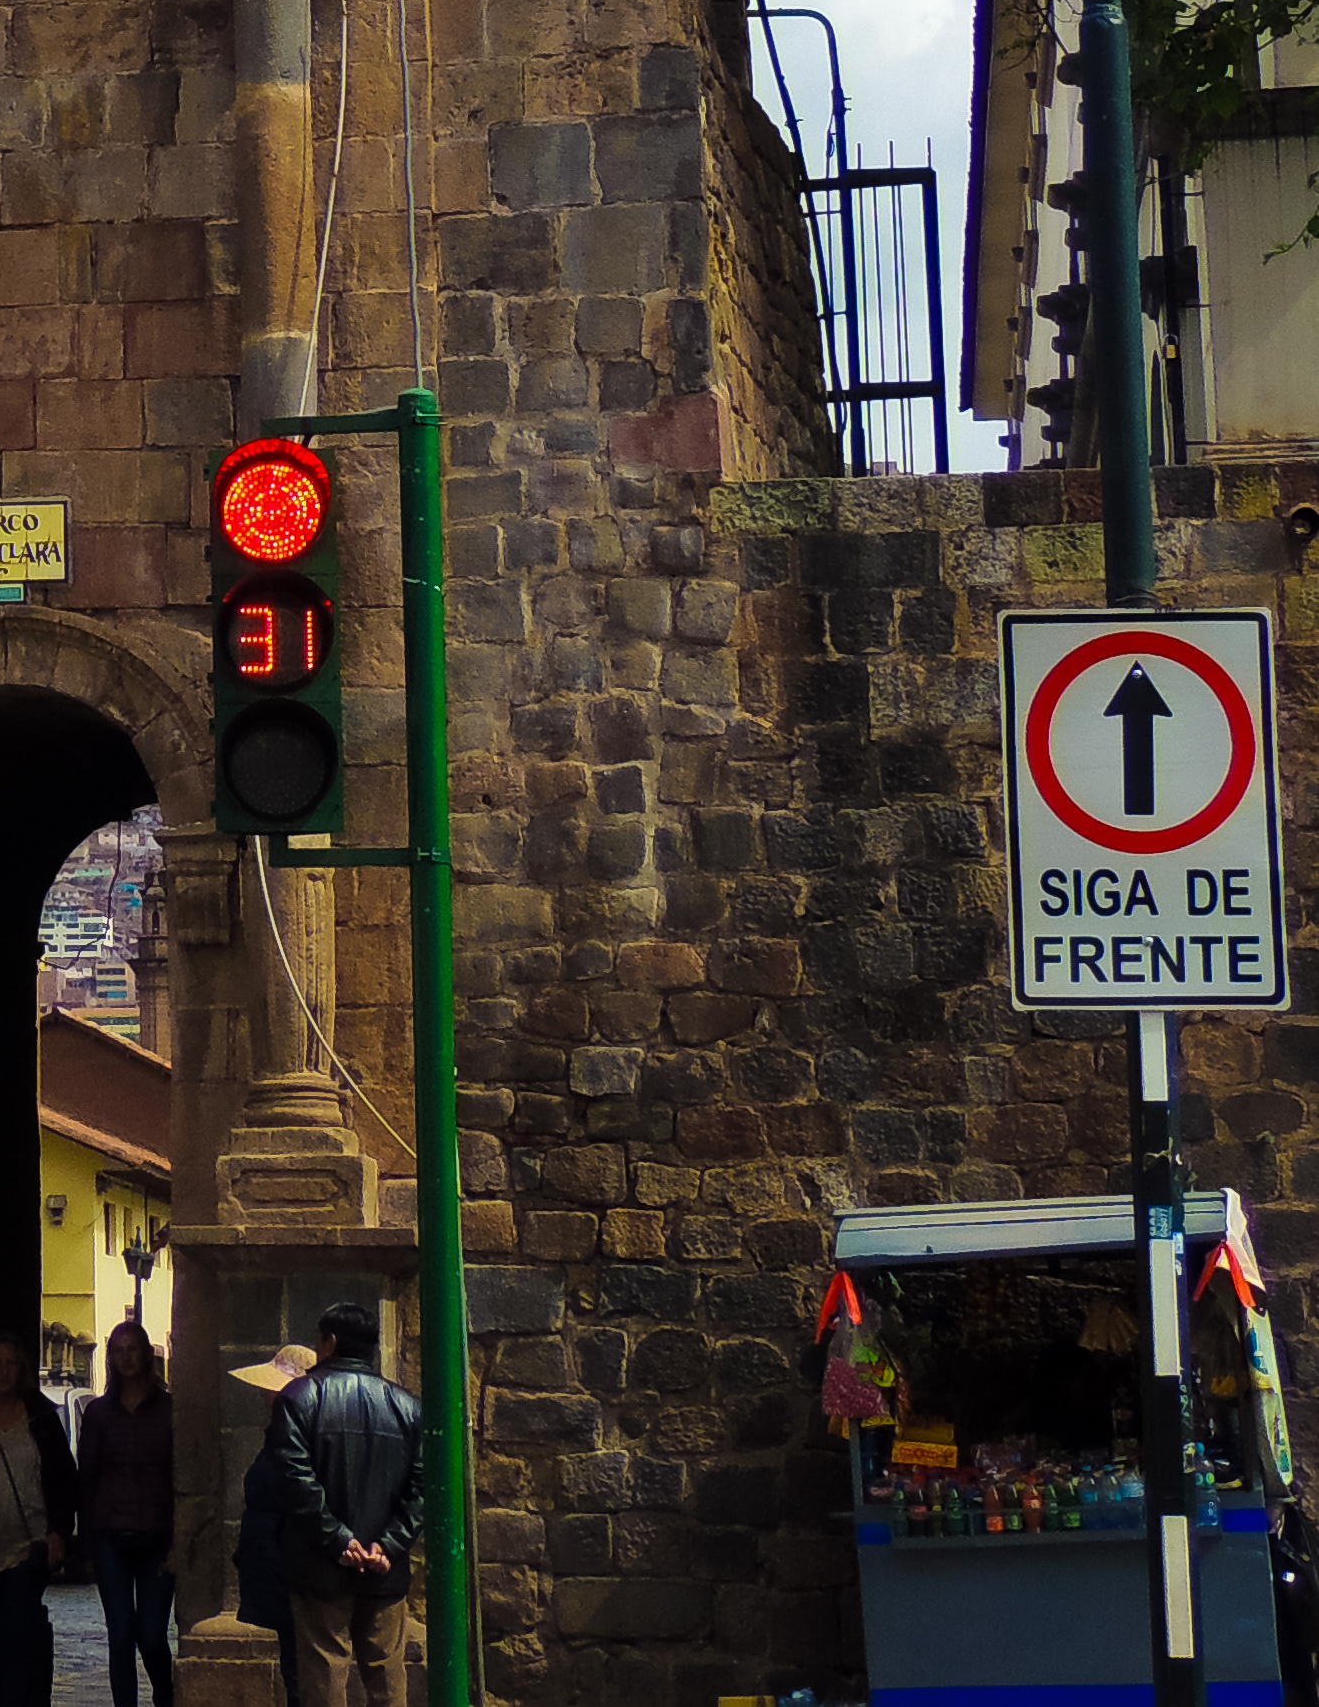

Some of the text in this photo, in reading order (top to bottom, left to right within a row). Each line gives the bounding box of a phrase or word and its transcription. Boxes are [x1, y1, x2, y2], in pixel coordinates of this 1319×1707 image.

[239, 605, 314, 675] 31
[1039, 868, 1252, 917] SIGA DE
[1033, 935, 1263, 984] FRENTE
